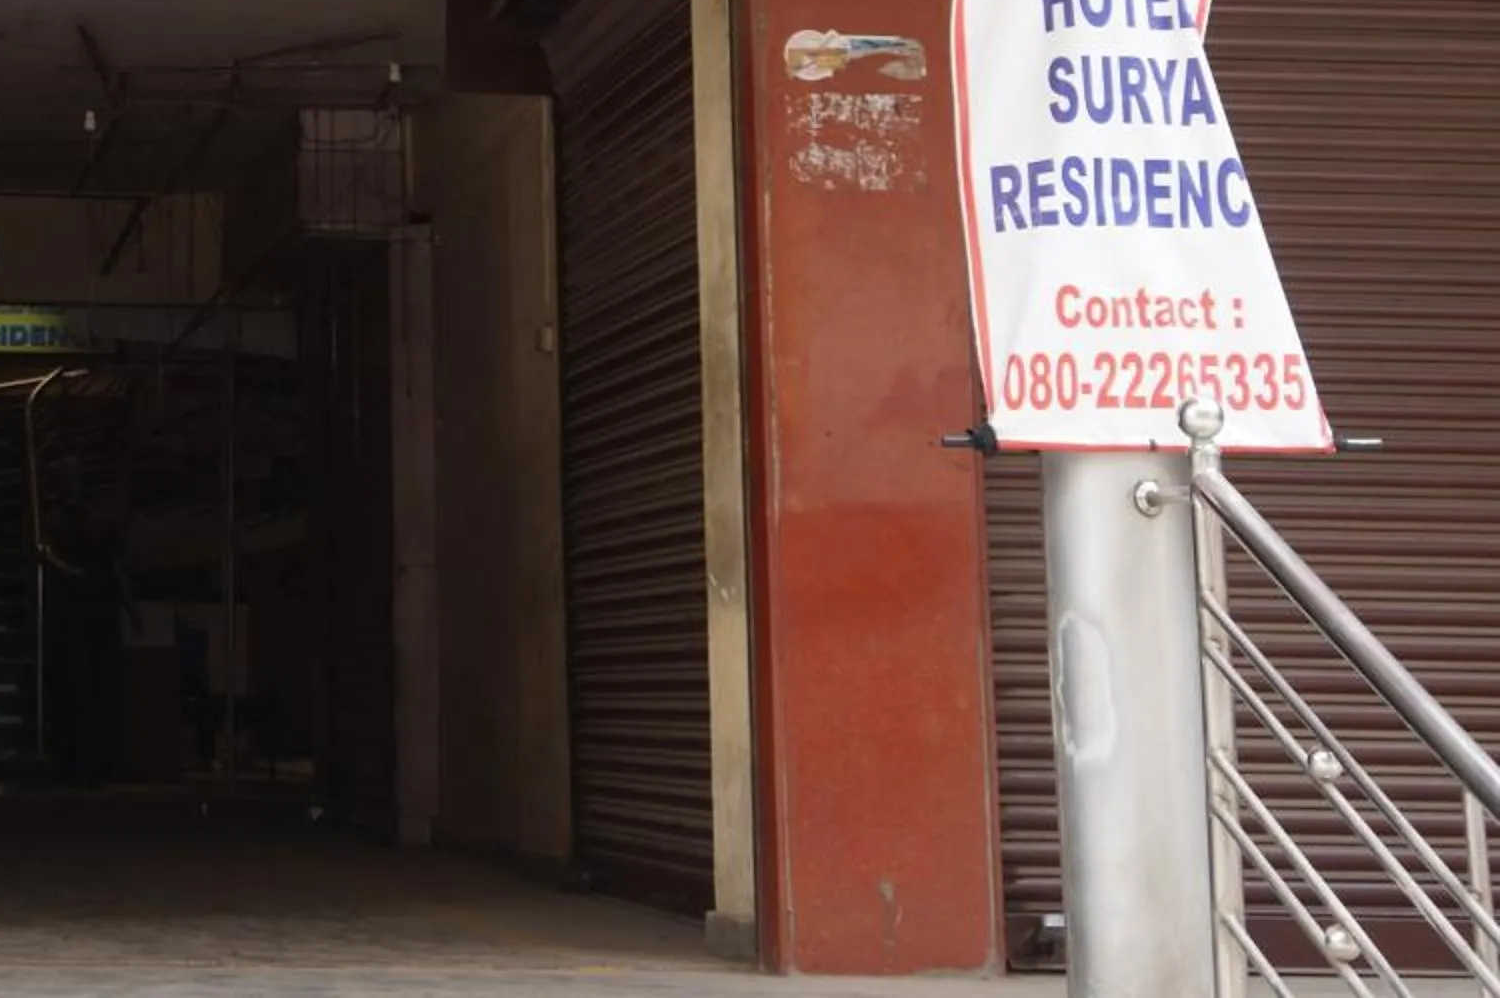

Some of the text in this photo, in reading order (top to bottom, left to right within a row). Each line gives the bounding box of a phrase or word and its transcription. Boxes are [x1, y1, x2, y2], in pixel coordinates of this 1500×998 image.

[1048, 55, 1217, 126] SURYA
[990, 155, 1251, 232] RESIDENC
[1003, 352, 1306, 411] 080-22265335
